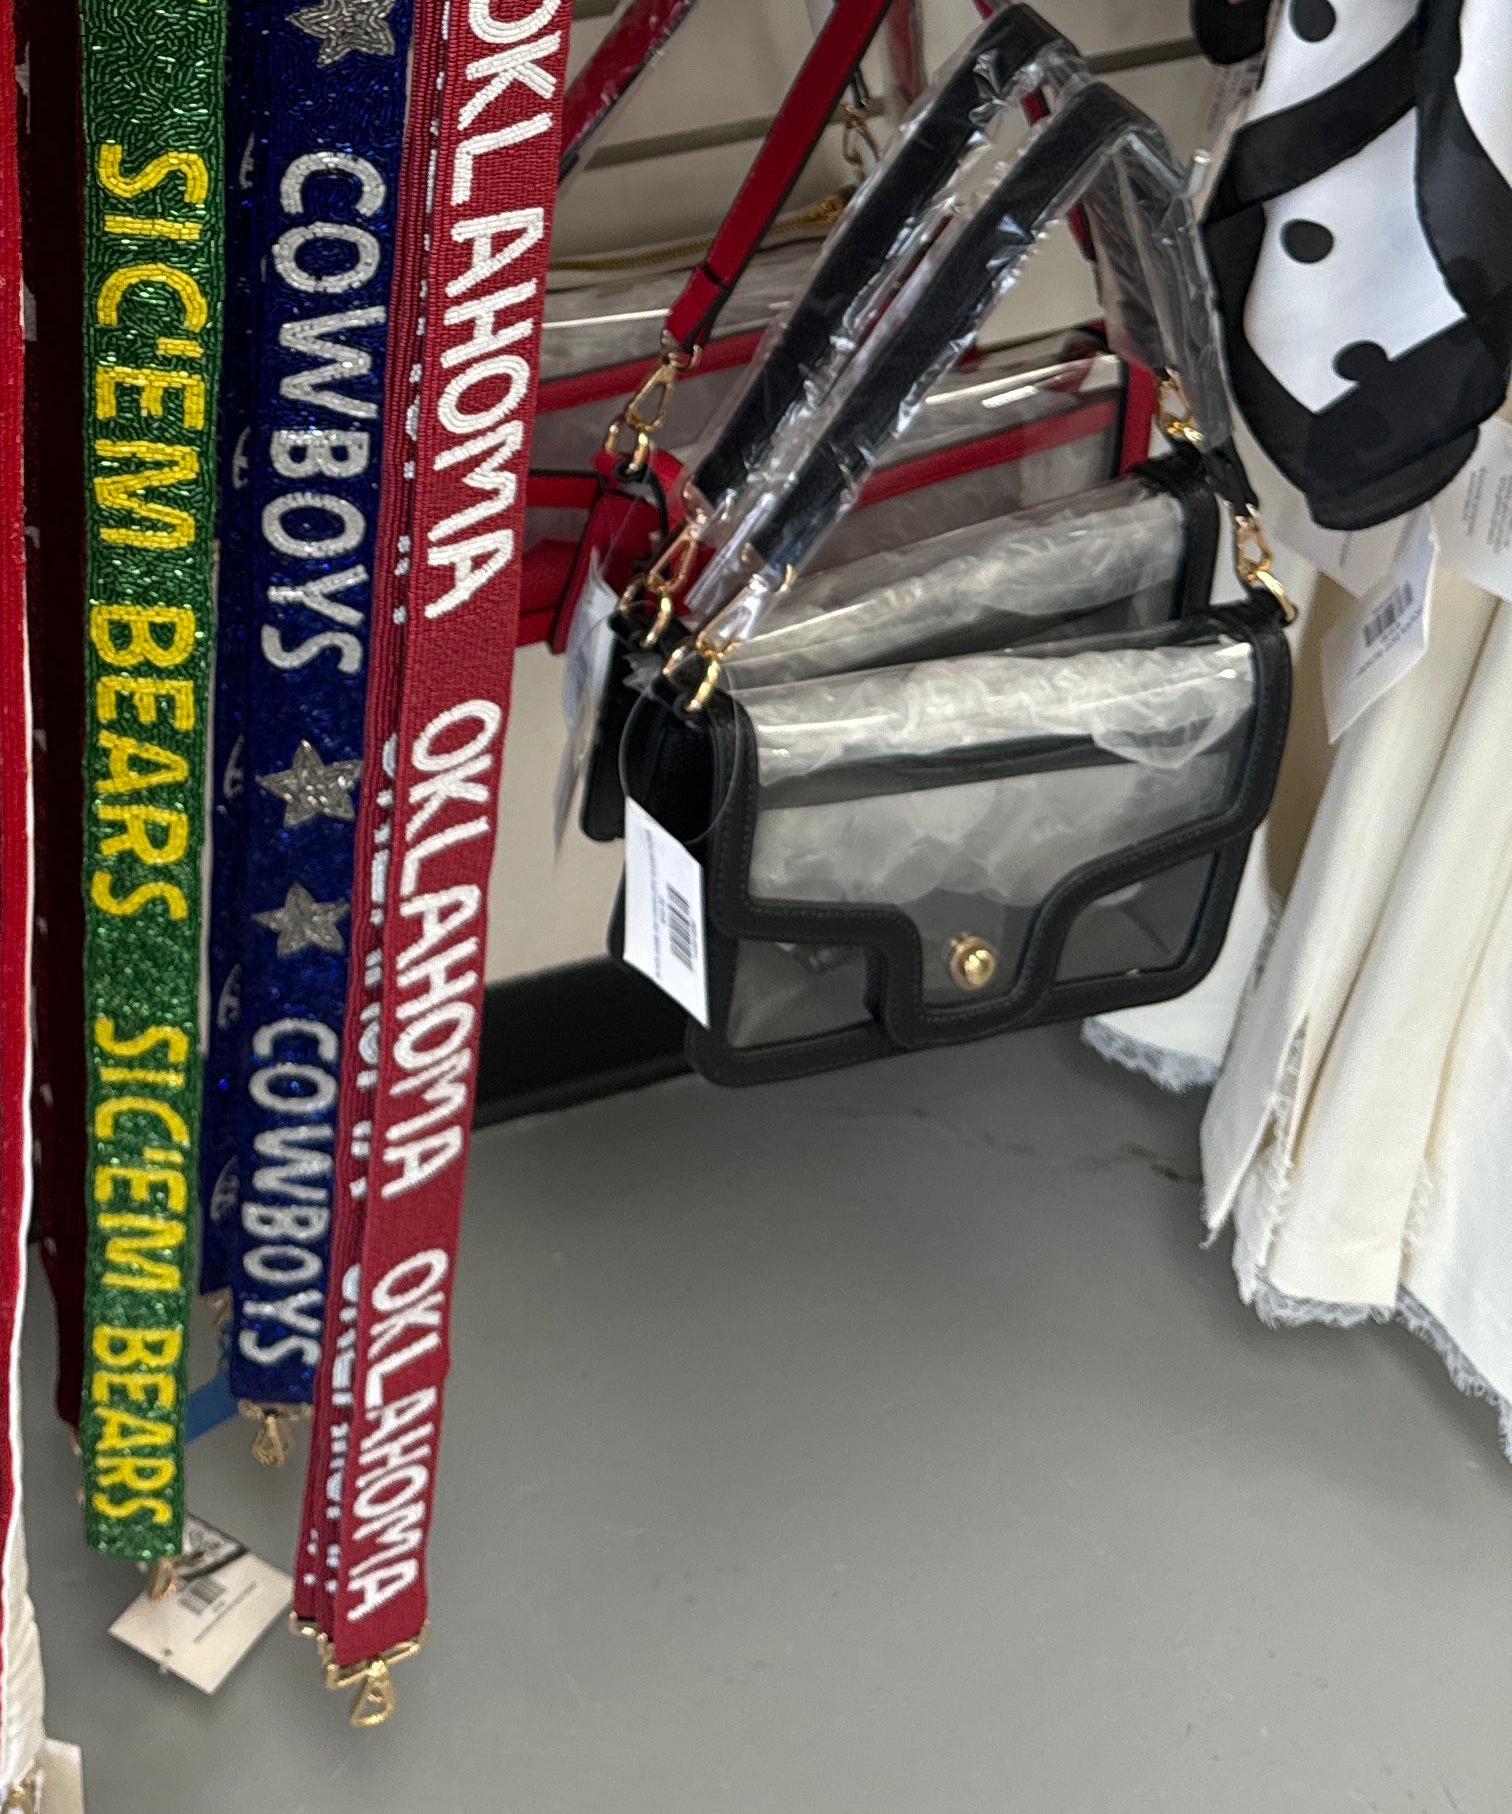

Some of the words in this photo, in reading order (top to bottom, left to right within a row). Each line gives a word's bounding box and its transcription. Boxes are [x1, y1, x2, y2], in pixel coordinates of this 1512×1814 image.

[262, 151, 386, 674] COWBOYS
[90, 604, 196, 921] BEARS
[381, 698, 504, 1200] OKLAHOMA
[238, 1016, 339, 1367] COWBOYS
[92, 1323, 183, 1526] BEARS
[347, 1248, 450, 1622] OKLAHOMA
